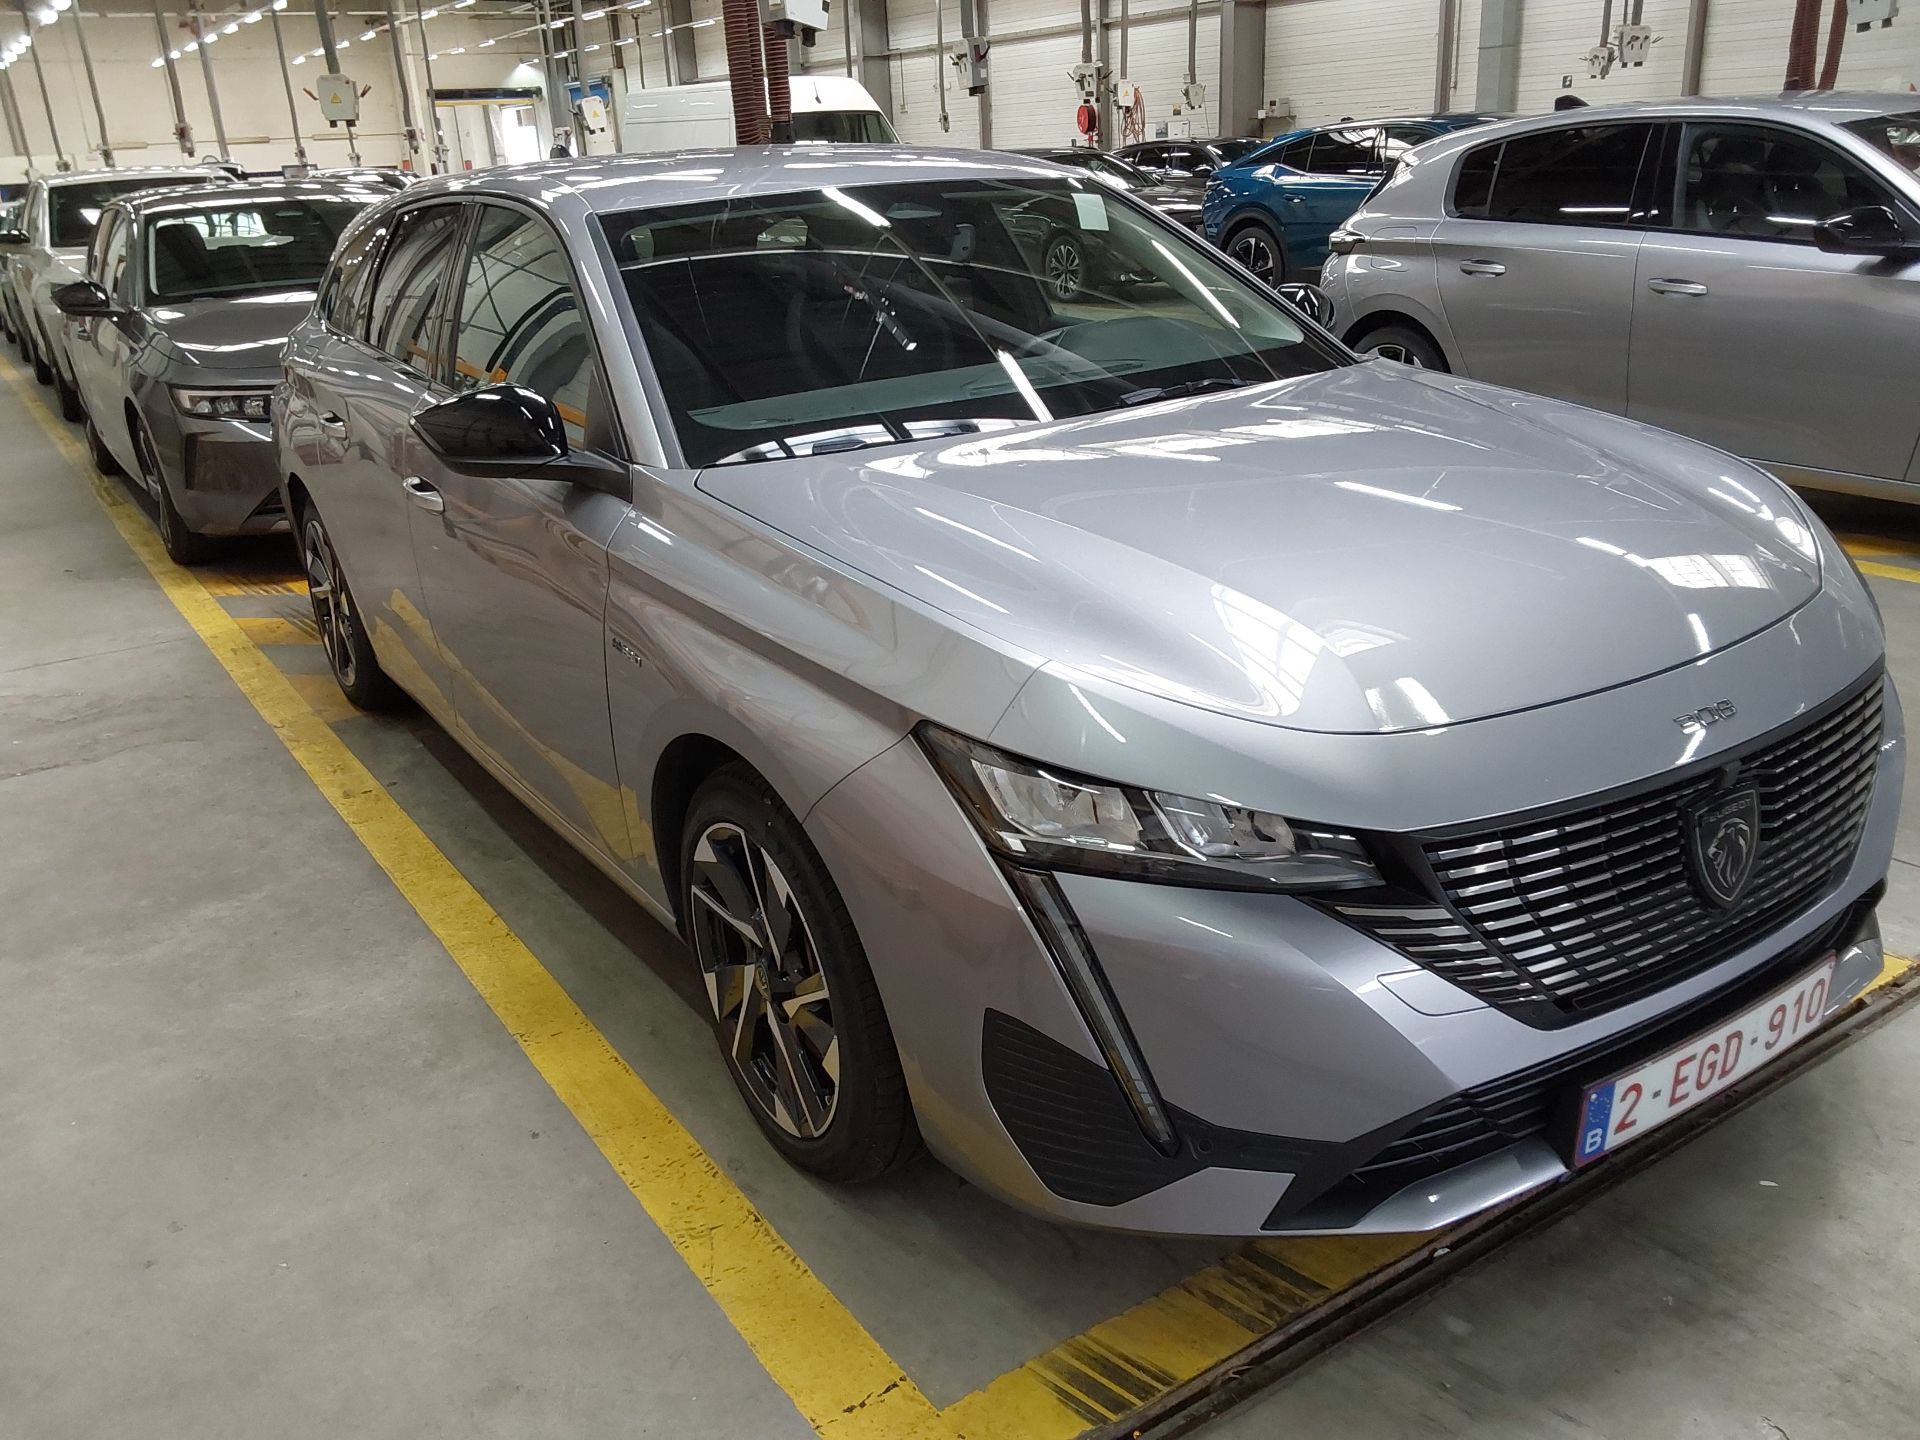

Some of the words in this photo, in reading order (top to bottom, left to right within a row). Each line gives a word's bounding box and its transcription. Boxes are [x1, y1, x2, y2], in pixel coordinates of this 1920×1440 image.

[1673, 699, 1737, 735] 308
[1614, 977, 1826, 1136] 2-EGD-910
[1584, 1127, 1604, 1154] B
